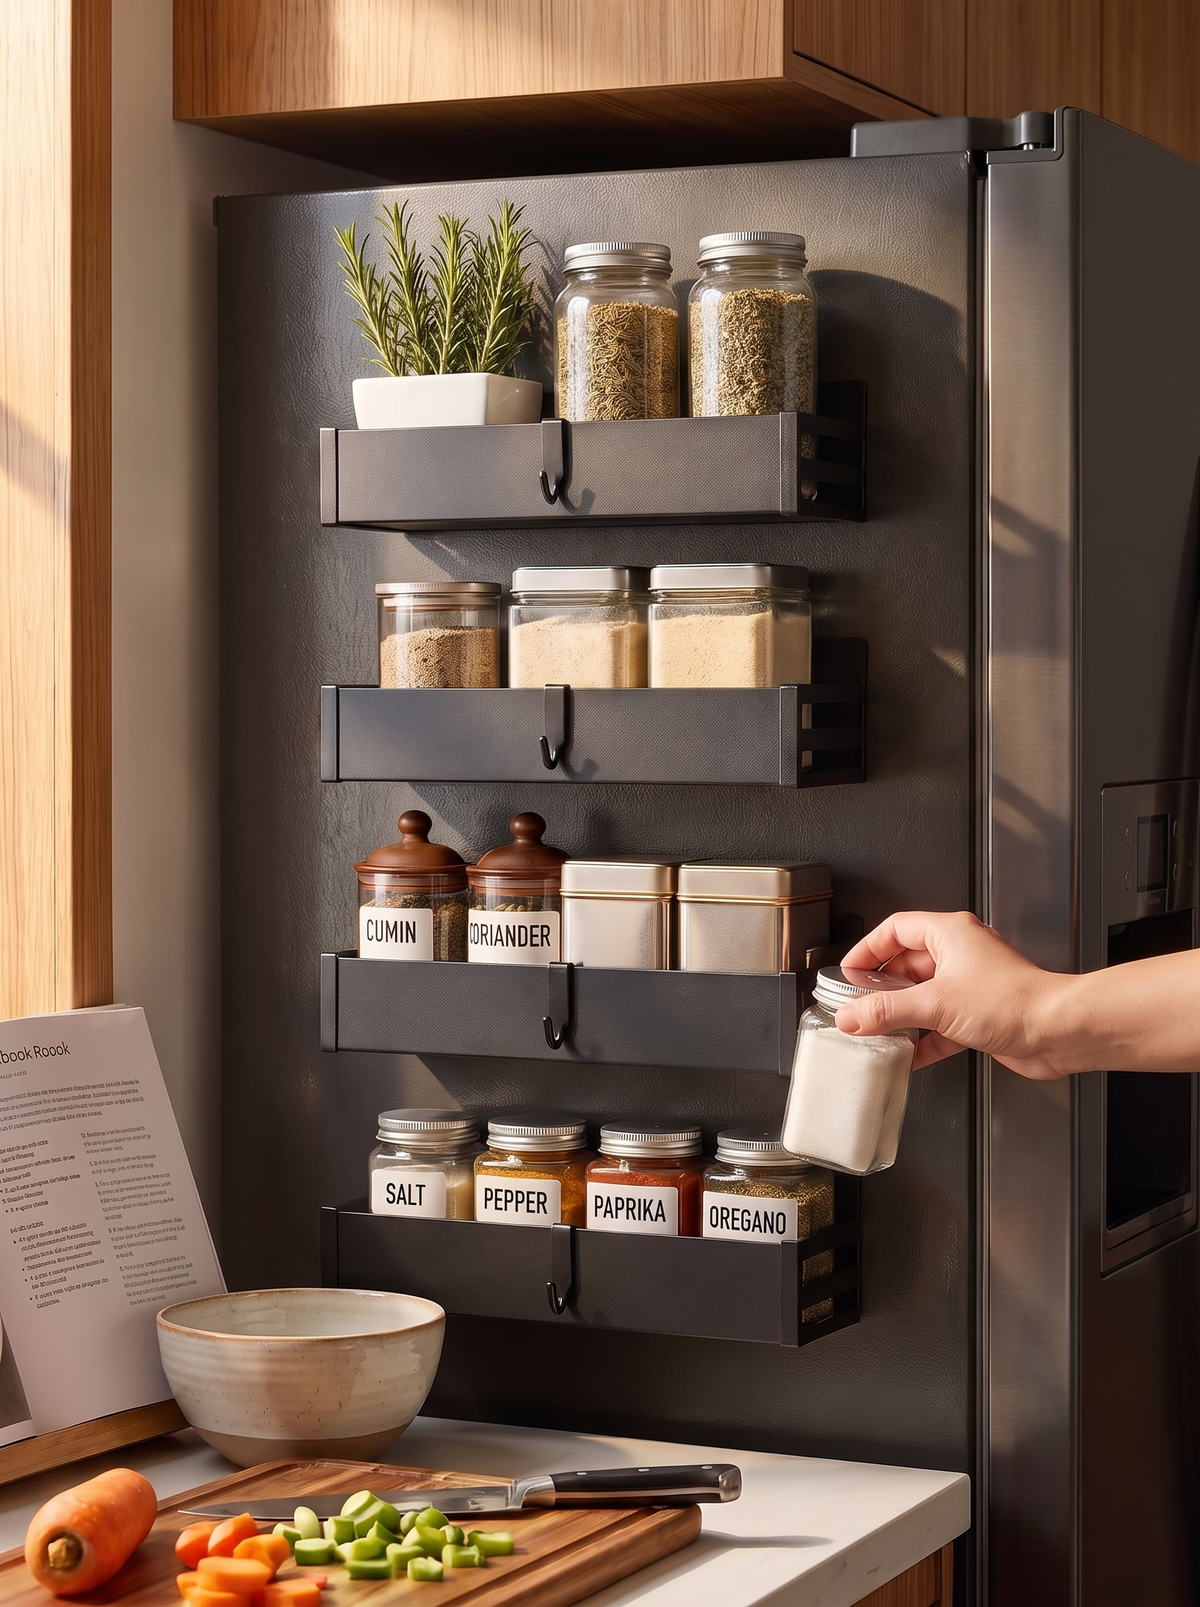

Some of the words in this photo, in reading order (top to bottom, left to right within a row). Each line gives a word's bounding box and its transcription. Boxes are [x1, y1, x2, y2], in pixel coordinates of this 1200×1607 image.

[366, 918, 417, 944] CUMIN
[469, 921, 552, 948] CORIANDER
[0, 1046, 33, 1064] book
[33, 1041, 71, 1059] Roook
[386, 1182, 427, 1207] SALT
[484, 1187, 549, 1215] PEPPER
[594, 1194, 667, 1223] PAPRIKA
[709, 1205, 787, 1235] OREGANO
